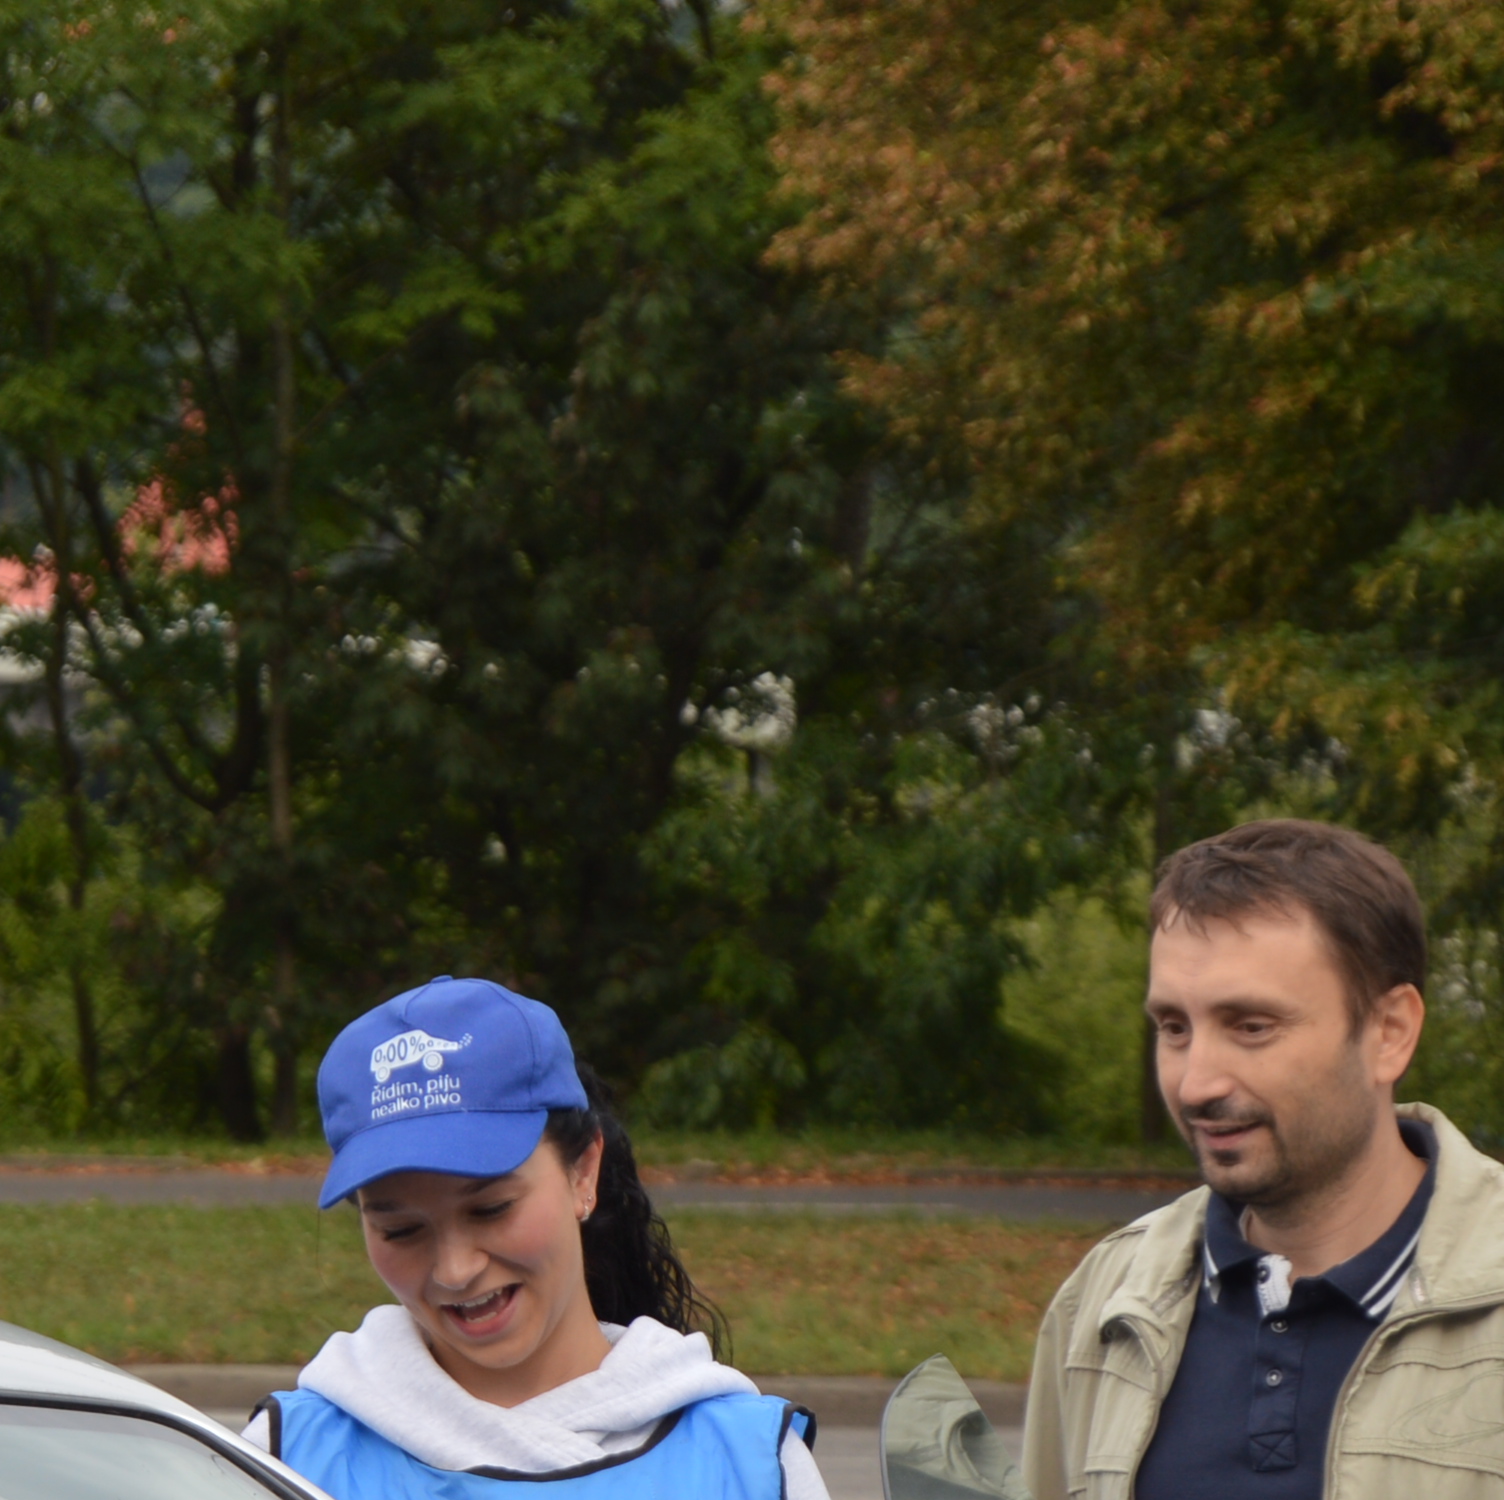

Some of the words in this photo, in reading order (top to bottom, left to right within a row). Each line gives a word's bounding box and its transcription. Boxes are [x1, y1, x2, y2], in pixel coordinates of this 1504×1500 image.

[426, 1074, 460, 1094] piju
[371, 1097, 420, 1119] nealko
[424, 1090, 461, 1109] pivo
